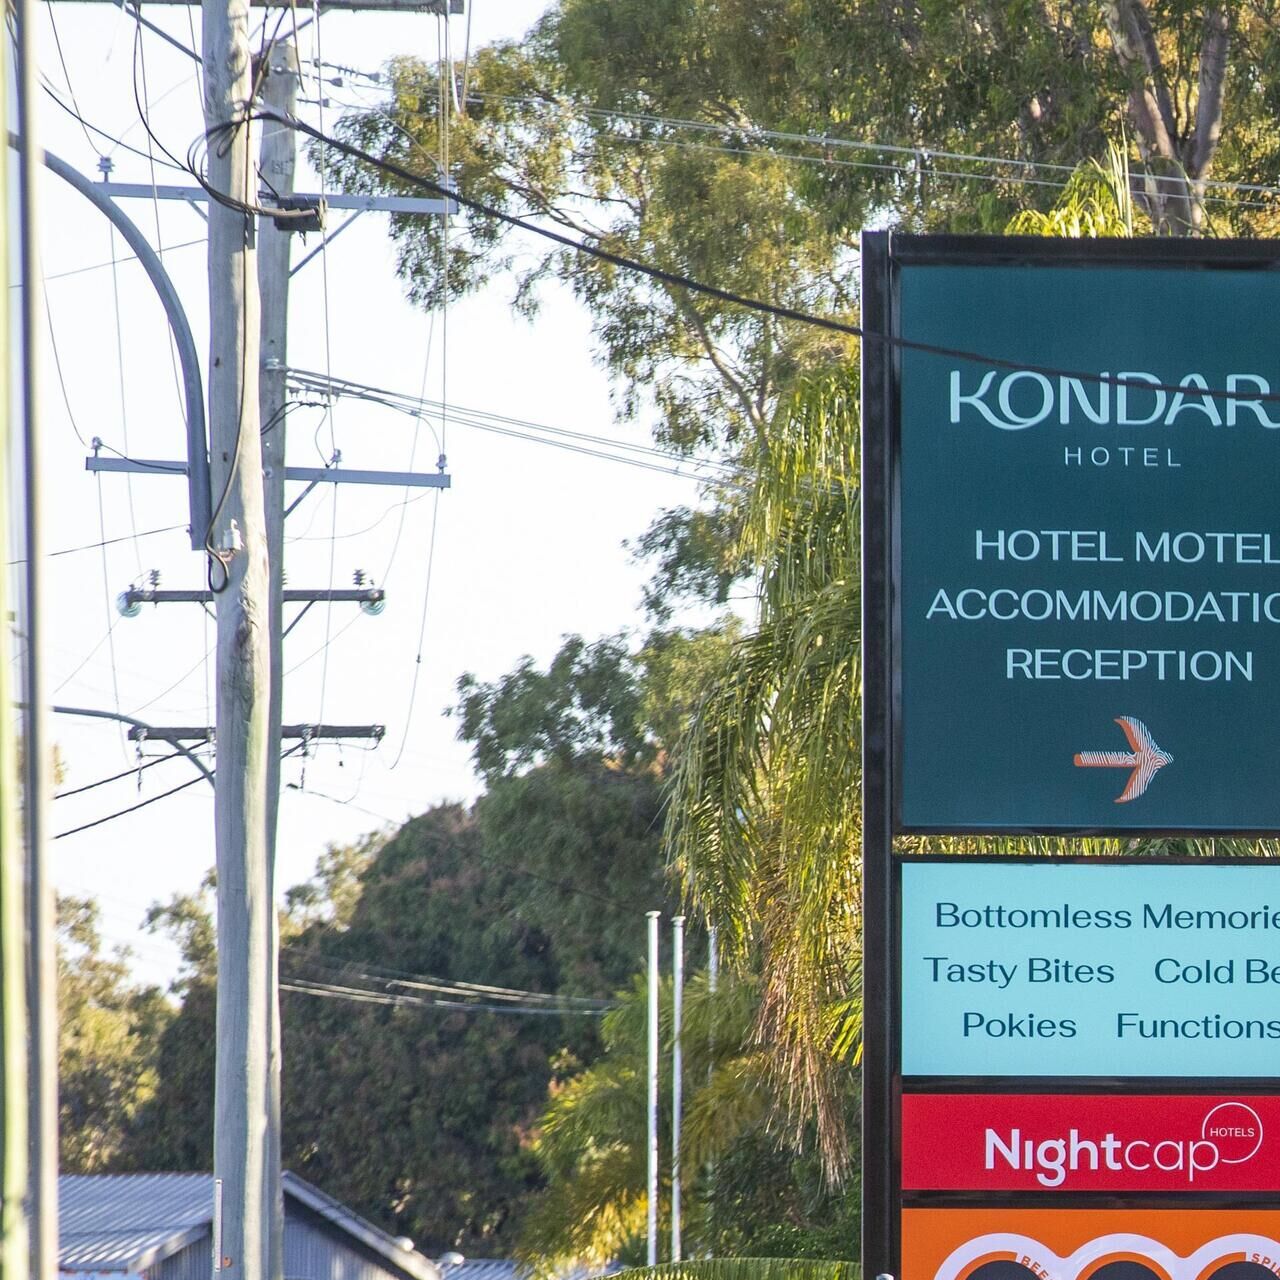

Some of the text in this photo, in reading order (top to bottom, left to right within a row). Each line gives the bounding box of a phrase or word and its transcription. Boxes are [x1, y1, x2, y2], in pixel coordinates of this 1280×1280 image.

[1064, 446, 1182, 468] HOTEL
[975, 529, 1124, 563] HOTEL
[1006, 648, 1254, 682] RECEPTION
[936, 902, 1132, 930] Bottomless
[922, 956, 1116, 989] Tasty Bites
[1154, 958, 1234, 985] Cold
[963, 1012, 1078, 1039] Pokies
[1209, 1127, 1255, 1138] HOTELS
[985, 1128, 1220, 1188] Nightcap
